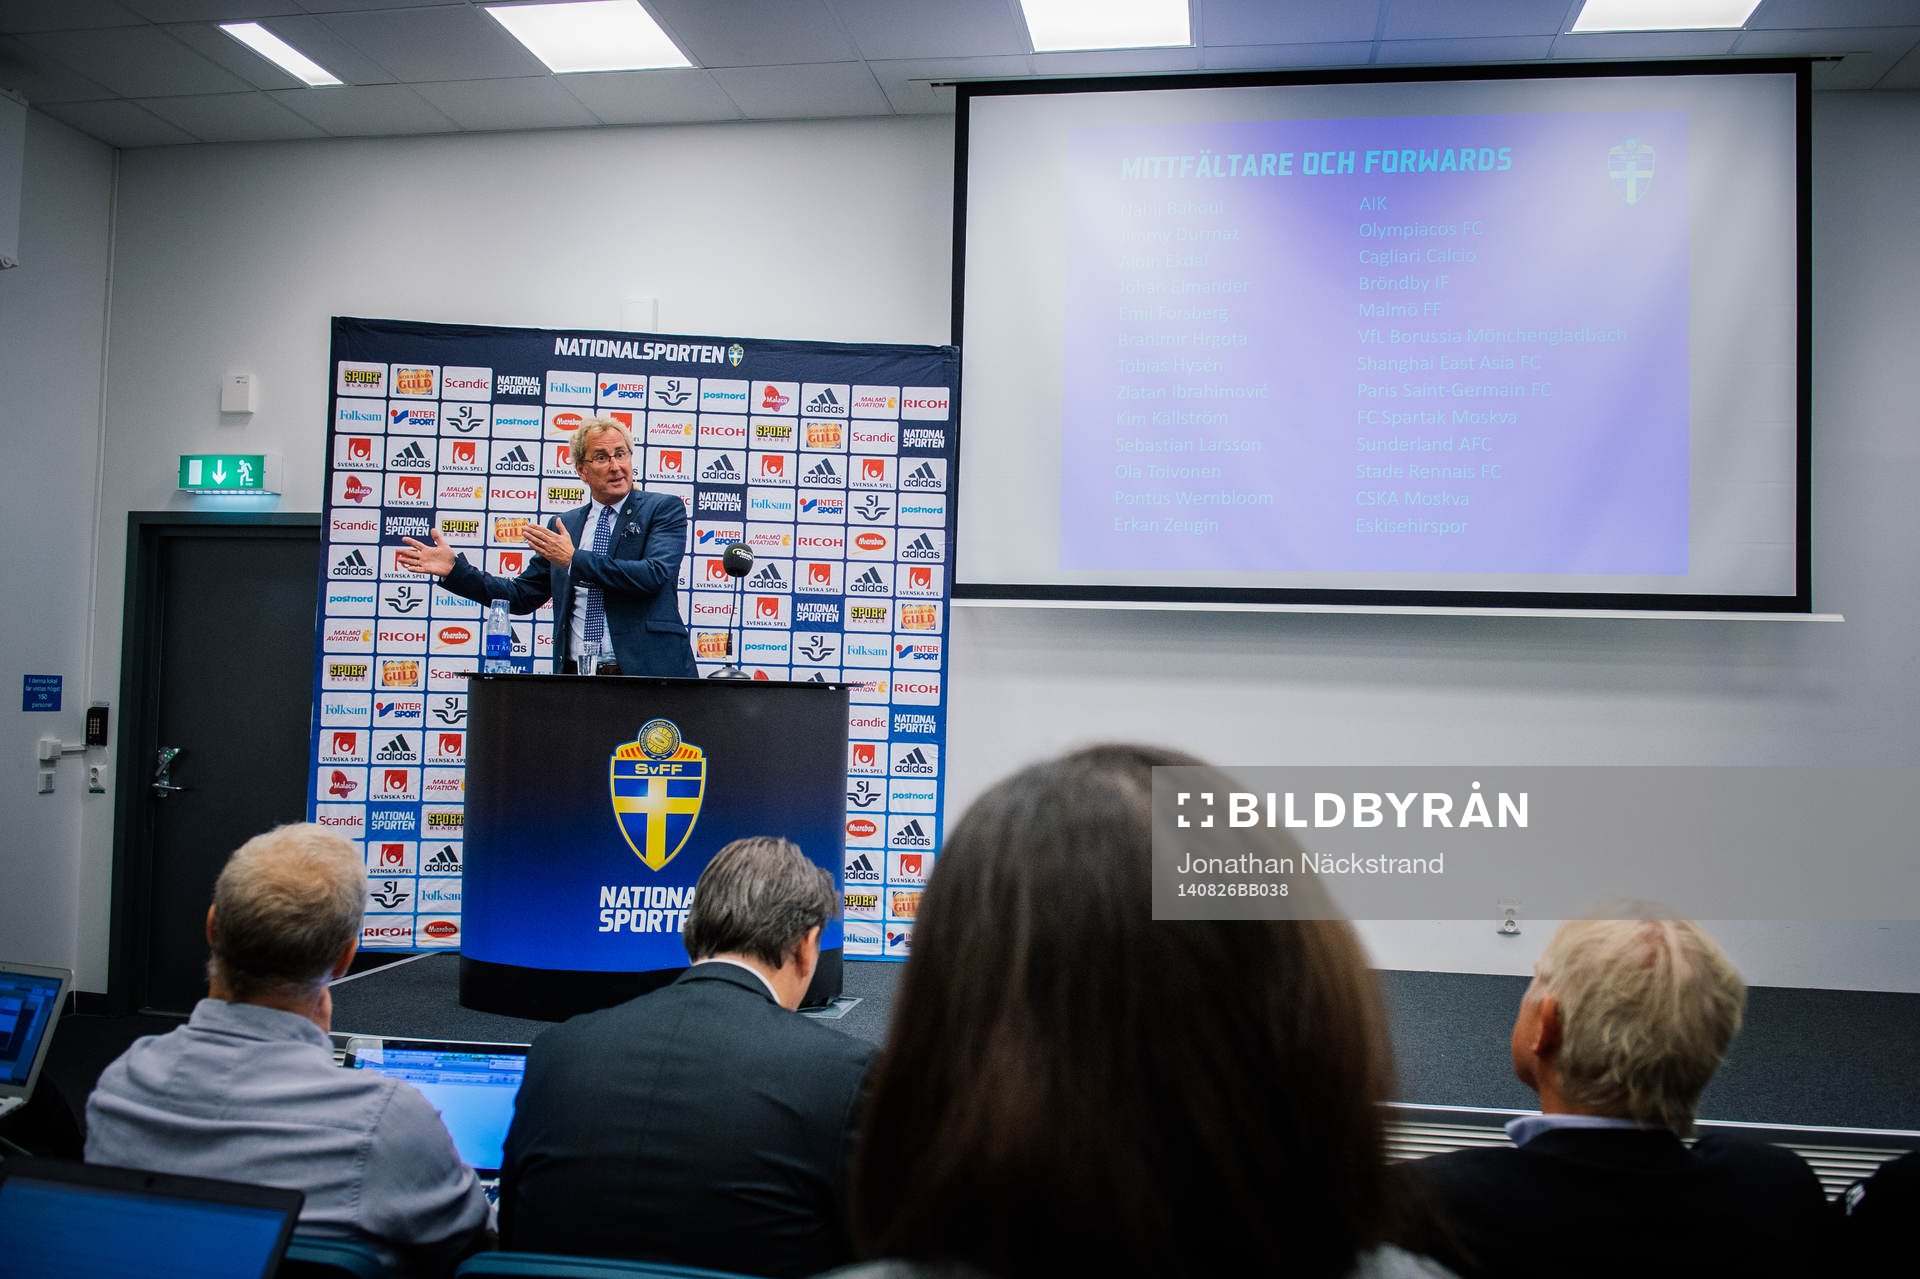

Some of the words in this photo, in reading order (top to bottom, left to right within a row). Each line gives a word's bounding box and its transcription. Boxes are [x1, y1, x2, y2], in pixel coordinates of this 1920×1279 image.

[1121, 150, 1294, 181] MITTFÄLTARE
[1304, 151, 1354, 175] OCH
[1365, 147, 1513, 174] FORWARDS
[1359, 196, 1387, 210] AIK
[1359, 223, 1456, 239] Olympiacos
[1464, 221, 1483, 236] FC
[1359, 249, 1420, 267] Cagliari
[1427, 247, 1476, 263] Calcio
[1359, 276, 1430, 292] Bröndby
[1436, 275, 1449, 289] IF
[1359, 303, 1417, 317] Malmö
[1424, 303, 1441, 317] FF
[1358, 329, 1385, 344] VfL
[1391, 329, 1462, 344] Borussia
[555, 337, 725, 364] NATIONALSPORTEN
[1358, 356, 1434, 374] Shanghai
[1440, 355, 1475, 370] East
[1480, 355, 1514, 369] Asia
[1520, 355, 1542, 369] FC
[344, 370, 382, 384] SPORT
[497, 375, 540, 388] NATIONAL
[398, 379, 432, 390] GULD
[445, 378, 489, 389] Scandic
[550, 382, 592, 394] Folksam
[618, 383, 644, 392] INTER
[668, 380, 680, 392] SJ
[497, 384, 540, 396] SPORTEN
[618, 390, 644, 399] SPORT
[1116, 385, 1166, 400] Zlatan
[1358, 383, 1397, 398] Paris
[1403, 383, 1525, 398] Saint-Germain
[1531, 383, 1553, 397] FC
[703, 391, 745, 402] postnord
[806, 403, 845, 414] adidas
[854, 401, 886, 409] AVIATION
[904, 399, 948, 409] RICOH
[1116, 410, 1146, 425] Kim
[1358, 410, 1377, 425] FC
[1382, 409, 1446, 428] Spartak
[1452, 409, 1518, 425] Moskva
[756, 425, 792, 438] SPORT
[903, 429, 945, 440] NATIONAL
[853, 432, 896, 443] Scandic
[903, 437, 944, 449] SPORTEN
[1115, 437, 1193, 452] Sebastian
[1200, 437, 1262, 452] Larsson
[1356, 437, 1452, 451] Sunderland
[1459, 437, 1493, 451] AFC
[391, 457, 431, 468] adidas
[1115, 464, 1142, 479] Ola
[1147, 464, 1222, 479] Toivonen
[1356, 464, 1404, 479] Stade
[1409, 464, 1475, 479] Rennais
[1481, 464, 1502, 479] FC
[804, 474, 842, 485] adidas
[904, 477, 942, 488] adidas
[439, 491, 472, 499] AVIATION
[548, 487, 585, 501] SPORT
[1115, 490, 1171, 504] Pontus
[1356, 491, 1399, 505] CSKA
[1405, 491, 1469, 505] Moskva
[751, 499, 792, 511] Folksam
[866, 495, 878, 506] SJ
[901, 505, 943, 515] postnord
[333, 520, 377, 531] Scandic
[387, 516, 430, 528] NATIONAL
[1114, 517, 1159, 531] Erkan
[1164, 517, 1219, 534] Zengin
[386, 526, 429, 537] SPORTEN
[798, 537, 843, 547] RICOH
[333, 566, 373, 576] adidas
[749, 579, 788, 590] adidas
[398, 586, 411, 598] SJ
[329, 595, 373, 603] postnord
[797, 603, 839, 614] NATIONAL
[796, 611, 839, 622] SPORTEN
[379, 632, 426, 642] RICOH
[811, 635, 823, 647] SJ
[745, 642, 787, 652] postnord
[848, 645, 888, 656] Folksam
[914, 645, 938, 653] INTER
[914, 652, 938, 661] SPORT
[330, 664, 367, 677] SPORT
[384, 670, 418, 682] GULD
[894, 684, 939, 694] RICOH
[325, 704, 367, 715] Folksam
[395, 703, 421, 711] INTER
[394, 710, 421, 718] SPORT
[895, 714, 936, 725] NATIONAL
[894, 723, 936, 734] SPORTEN
[635, 764, 683, 775] SvFF
[892, 792, 934, 801] postnord
[319, 816, 364, 826] Scandic
[892, 836, 931, 846] adidas
[600, 886, 697, 908] NATIONA
[599, 909, 691, 932] SPORTE
[364, 928, 412, 937] RICOH
